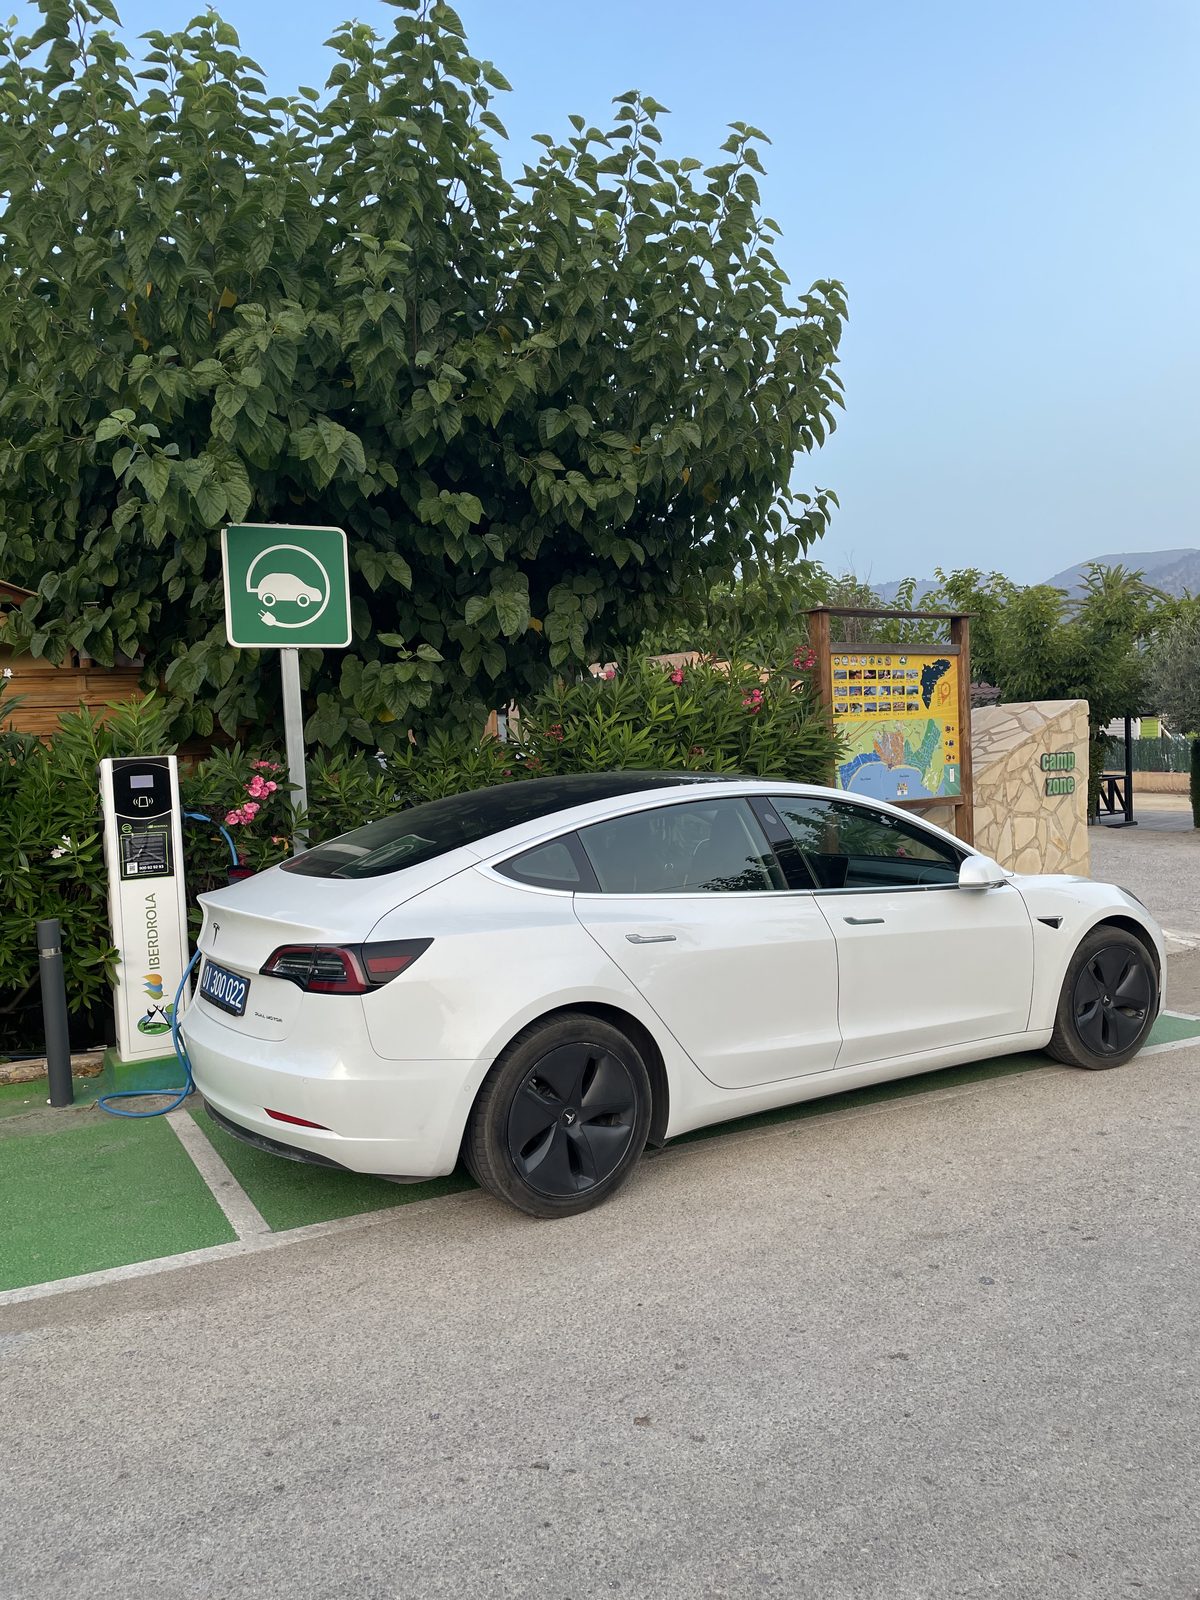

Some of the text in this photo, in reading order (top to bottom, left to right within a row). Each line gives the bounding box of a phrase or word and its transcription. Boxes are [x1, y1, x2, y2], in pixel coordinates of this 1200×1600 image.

[1040, 752, 1075, 772] camp
[1045, 776, 1075, 797] zone
[145, 892, 160, 970] IBERDROLA
[202, 965, 245, 1008] 01 300 022
